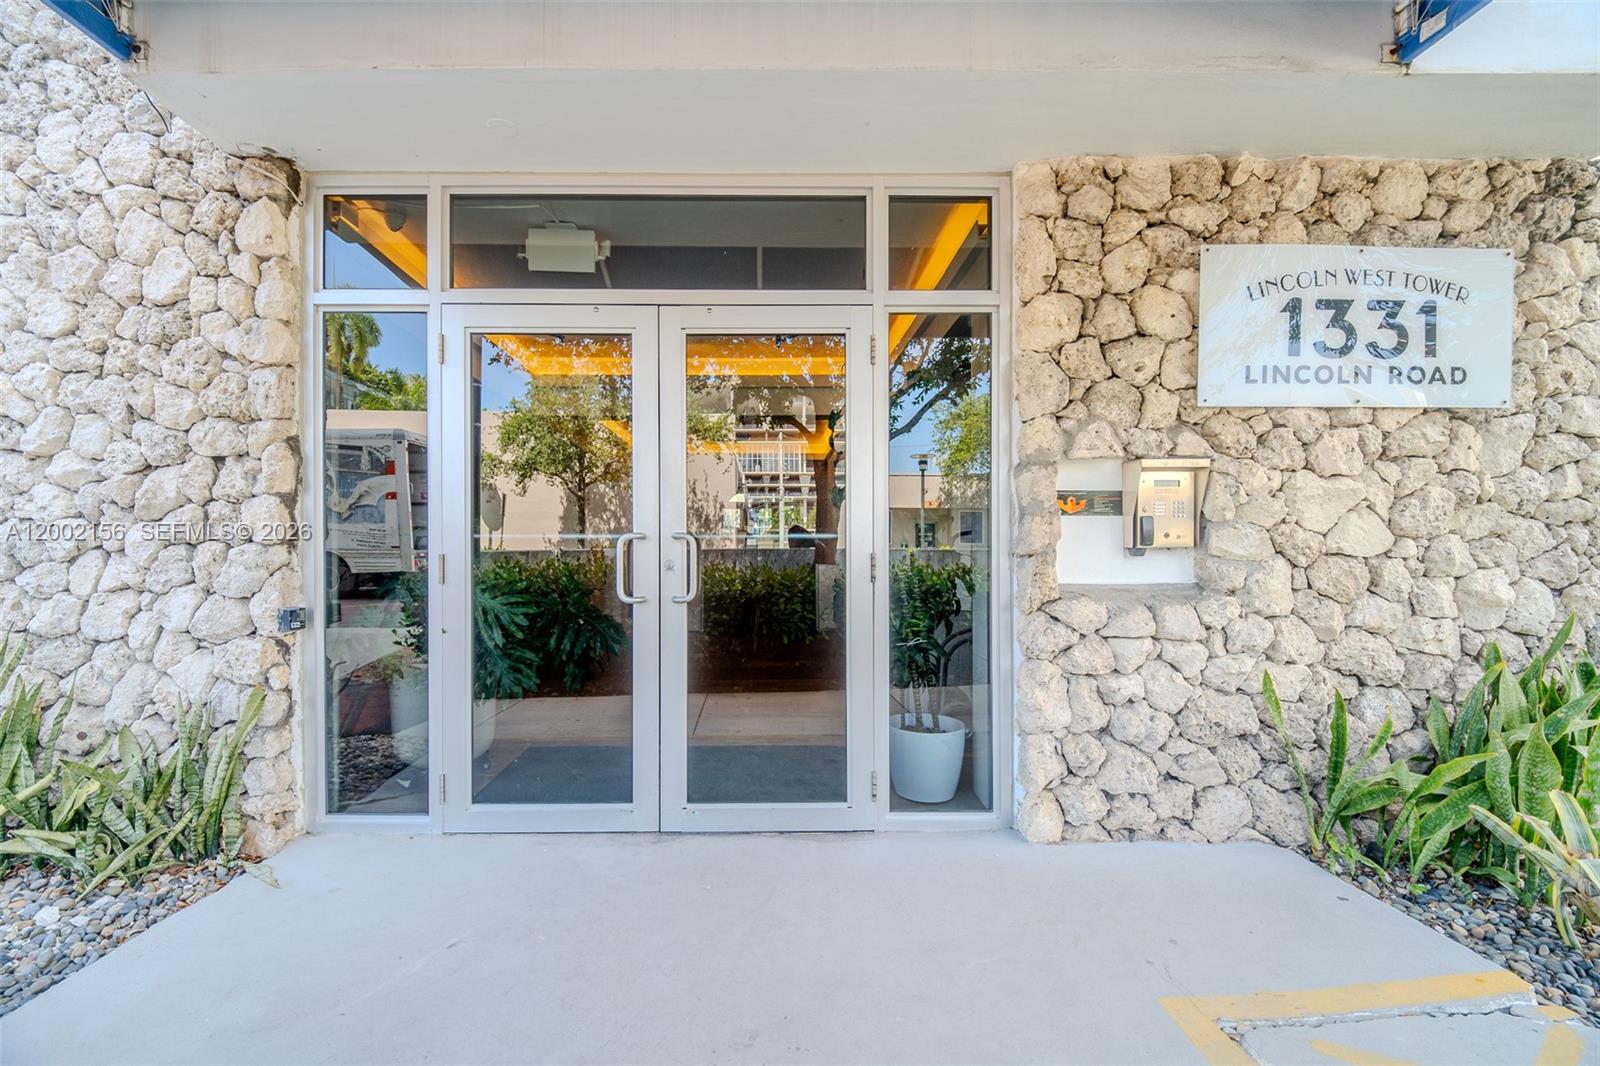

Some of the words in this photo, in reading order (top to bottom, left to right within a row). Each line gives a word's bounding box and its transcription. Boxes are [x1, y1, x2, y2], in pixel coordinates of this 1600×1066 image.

[1246, 269, 1337, 302] LINCOLN
[1344, 269, 1395, 288] WEST
[1403, 272, 1470, 305] TOWER
[1280, 297, 1437, 359] 1331
[1244, 365, 1372, 385] LINCOLN
[1388, 366, 1468, 385] ROAD
